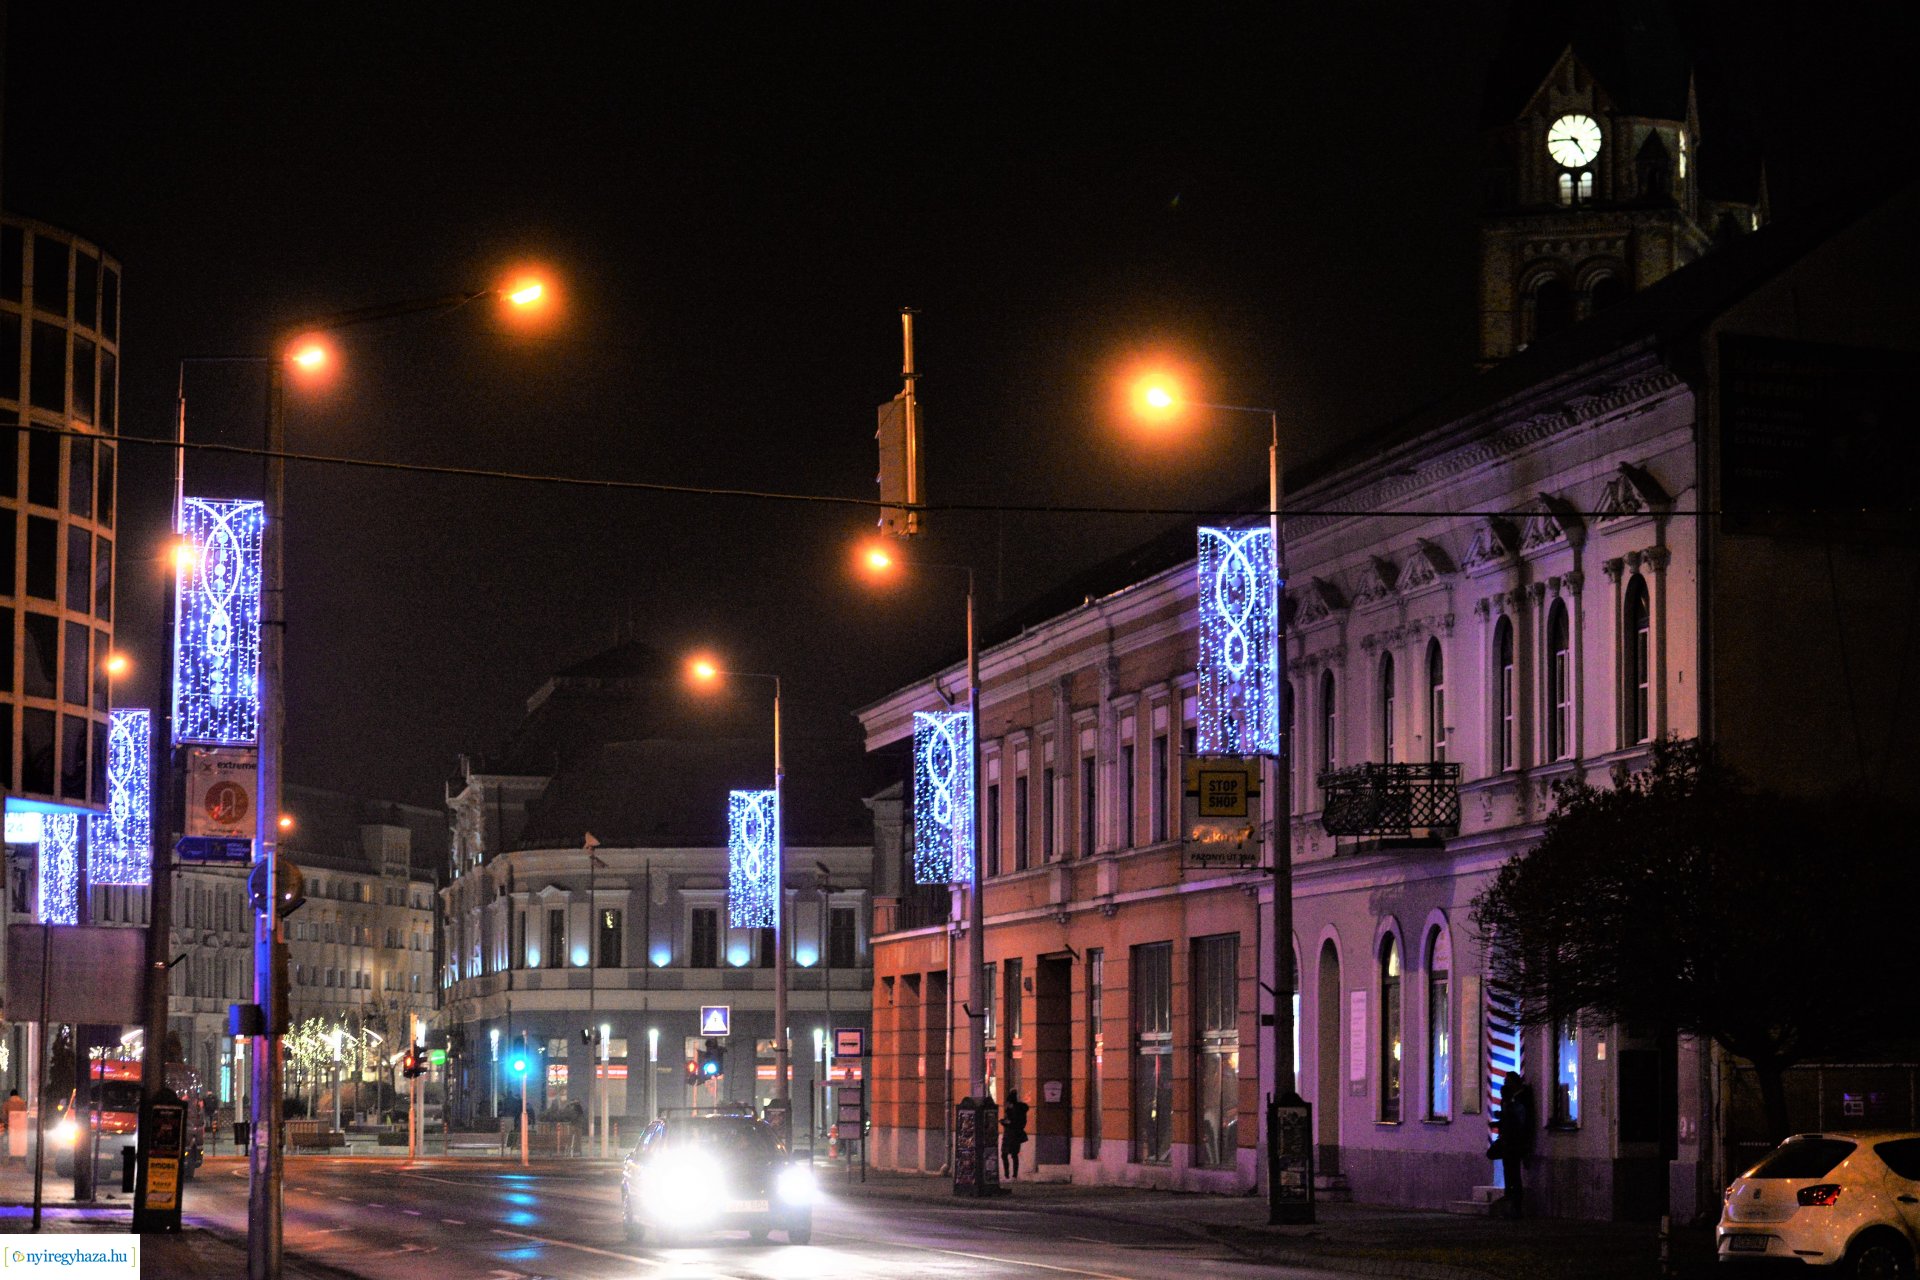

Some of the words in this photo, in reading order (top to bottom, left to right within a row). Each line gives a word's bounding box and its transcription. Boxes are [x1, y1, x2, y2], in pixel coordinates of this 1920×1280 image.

[217, 762, 257, 770] extreme
[1208, 780, 1238, 792] STOP
[1208, 796, 1238, 808] SHOP
